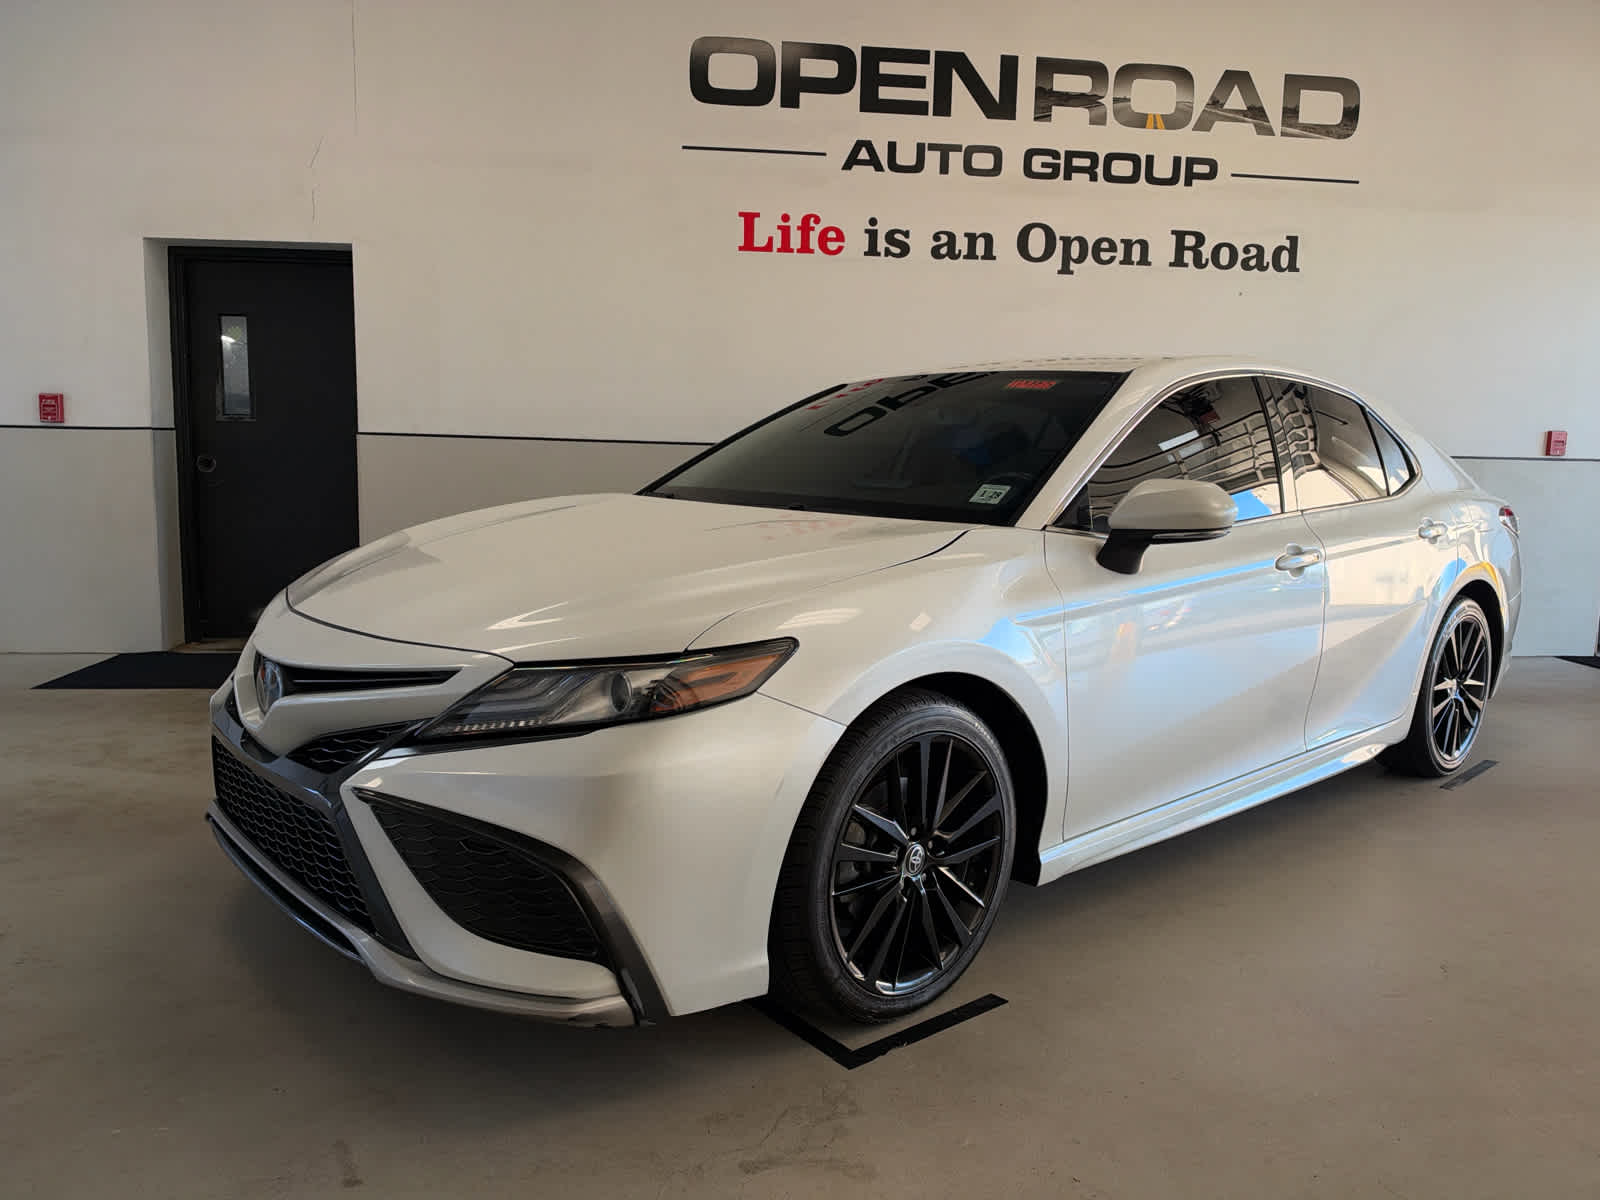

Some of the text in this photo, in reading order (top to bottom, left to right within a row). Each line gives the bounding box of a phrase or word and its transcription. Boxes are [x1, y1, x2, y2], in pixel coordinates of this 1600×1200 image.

[689, 36, 1360, 140] OPEN ROAD
[841, 140, 1218, 187] AUTO GROUP
[738, 212, 1300, 275] Life is an Open Road
